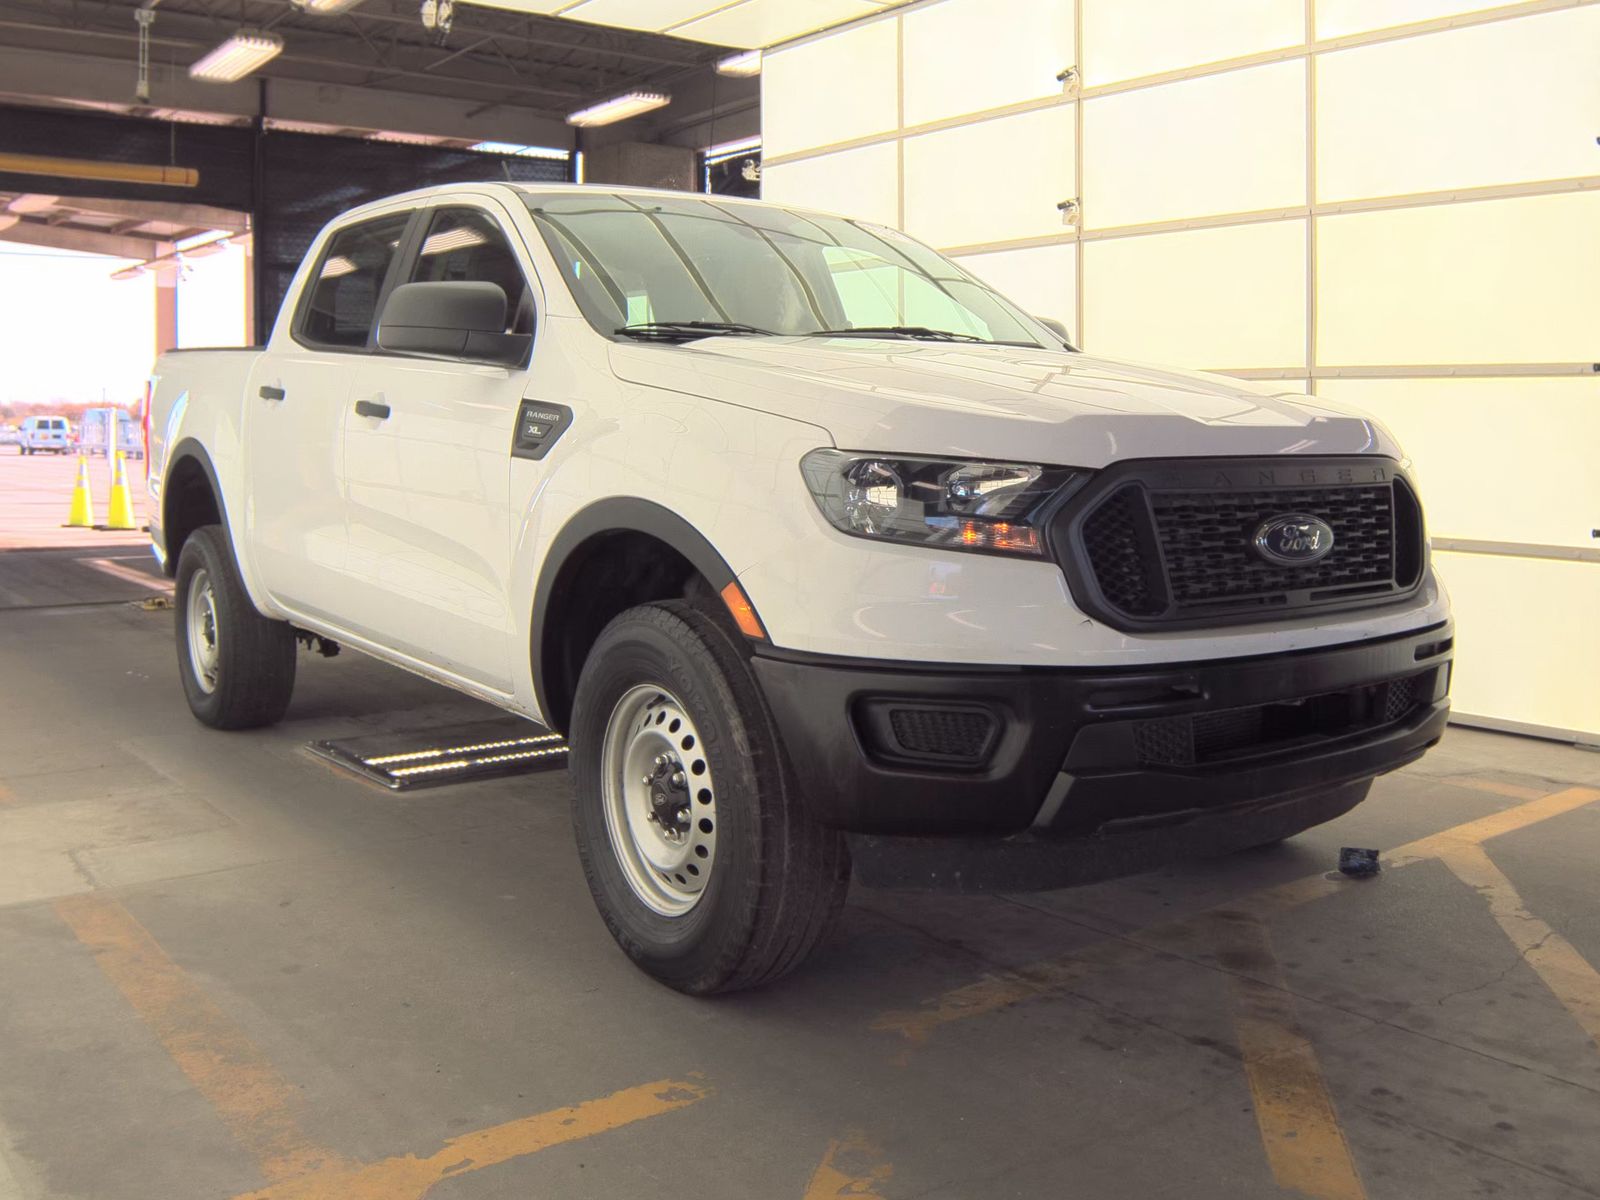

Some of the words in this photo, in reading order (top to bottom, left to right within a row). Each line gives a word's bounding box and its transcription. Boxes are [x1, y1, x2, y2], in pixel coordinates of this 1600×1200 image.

[526, 411, 559, 421] RANGER
[528, 425, 541, 435] XL
[1164, 468, 1386, 487] ANGER
[1280, 524, 1321, 552] Ford
